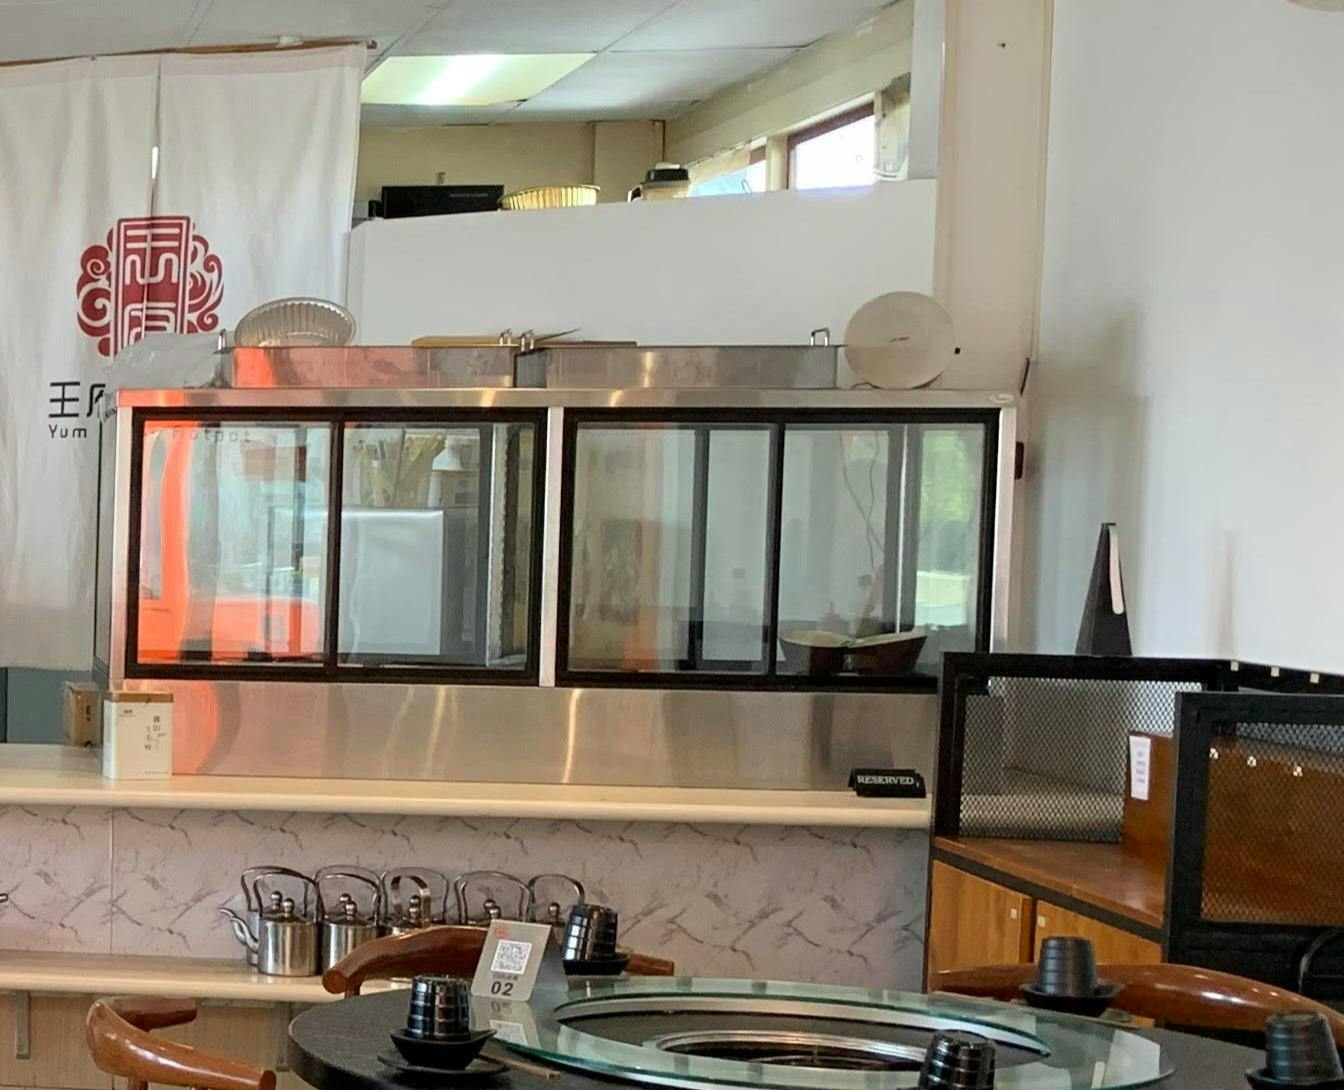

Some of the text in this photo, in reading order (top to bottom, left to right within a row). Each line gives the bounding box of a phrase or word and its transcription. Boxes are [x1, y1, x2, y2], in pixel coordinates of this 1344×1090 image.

[48, 424, 87, 439] Yum
[856, 775, 914, 785] RESERVED
[491, 981, 514, 996] 02
